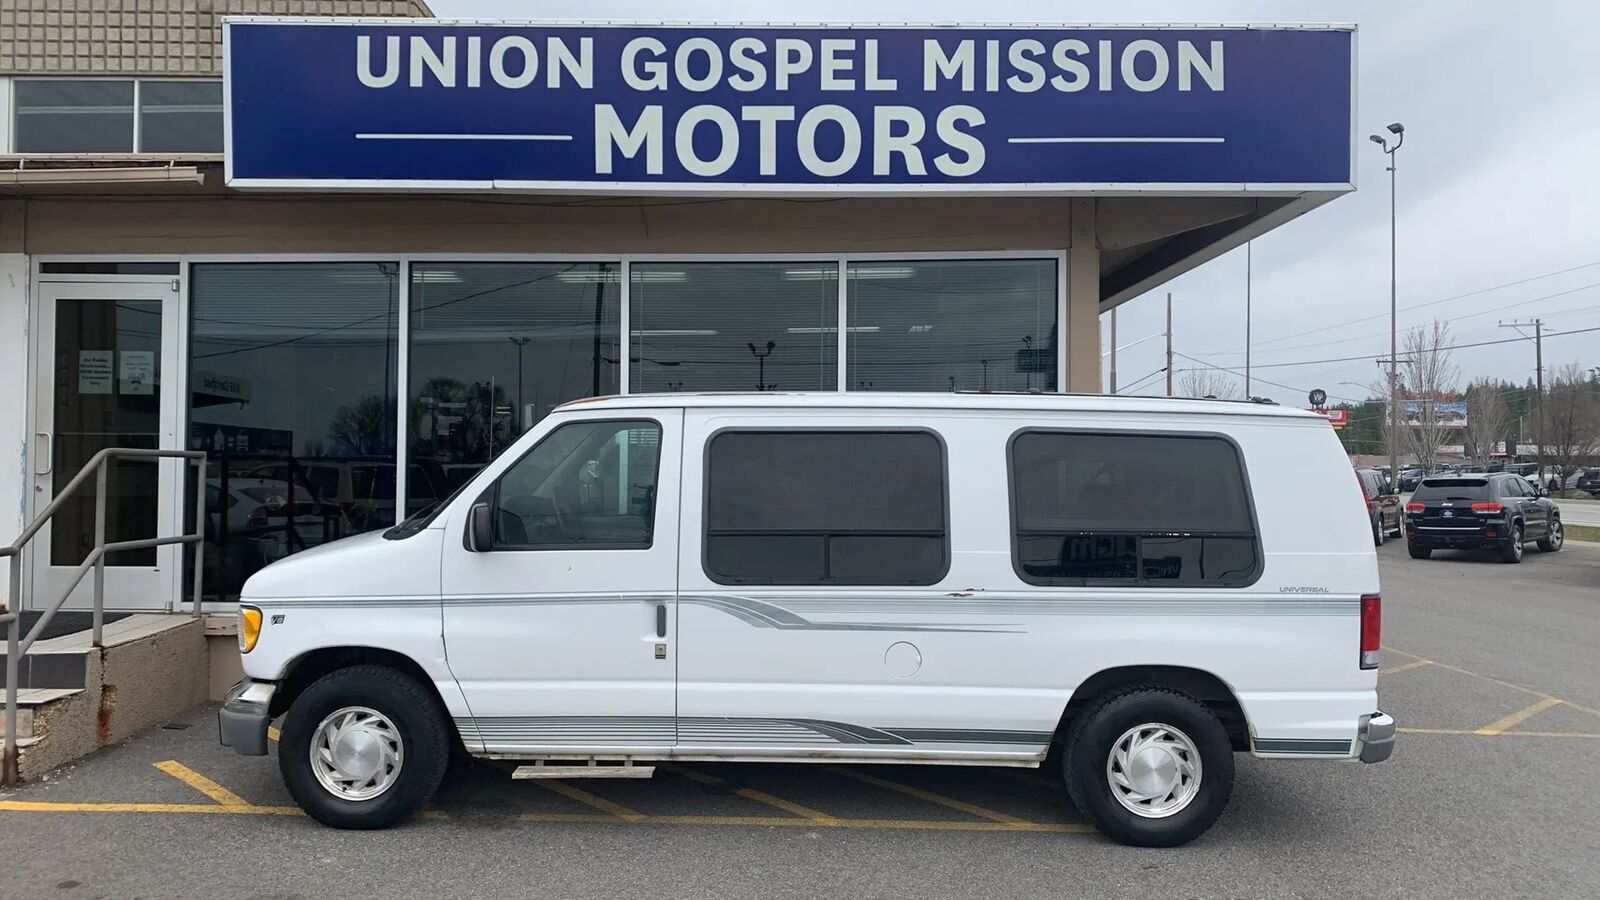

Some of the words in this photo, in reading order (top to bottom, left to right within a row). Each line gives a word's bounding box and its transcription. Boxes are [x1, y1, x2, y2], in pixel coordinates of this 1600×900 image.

[356, 36, 594, 89] UNION
[620, 37, 898, 92] GOSPEL
[923, 39, 1225, 93] MISSION
[594, 103, 986, 177] MOTORS
